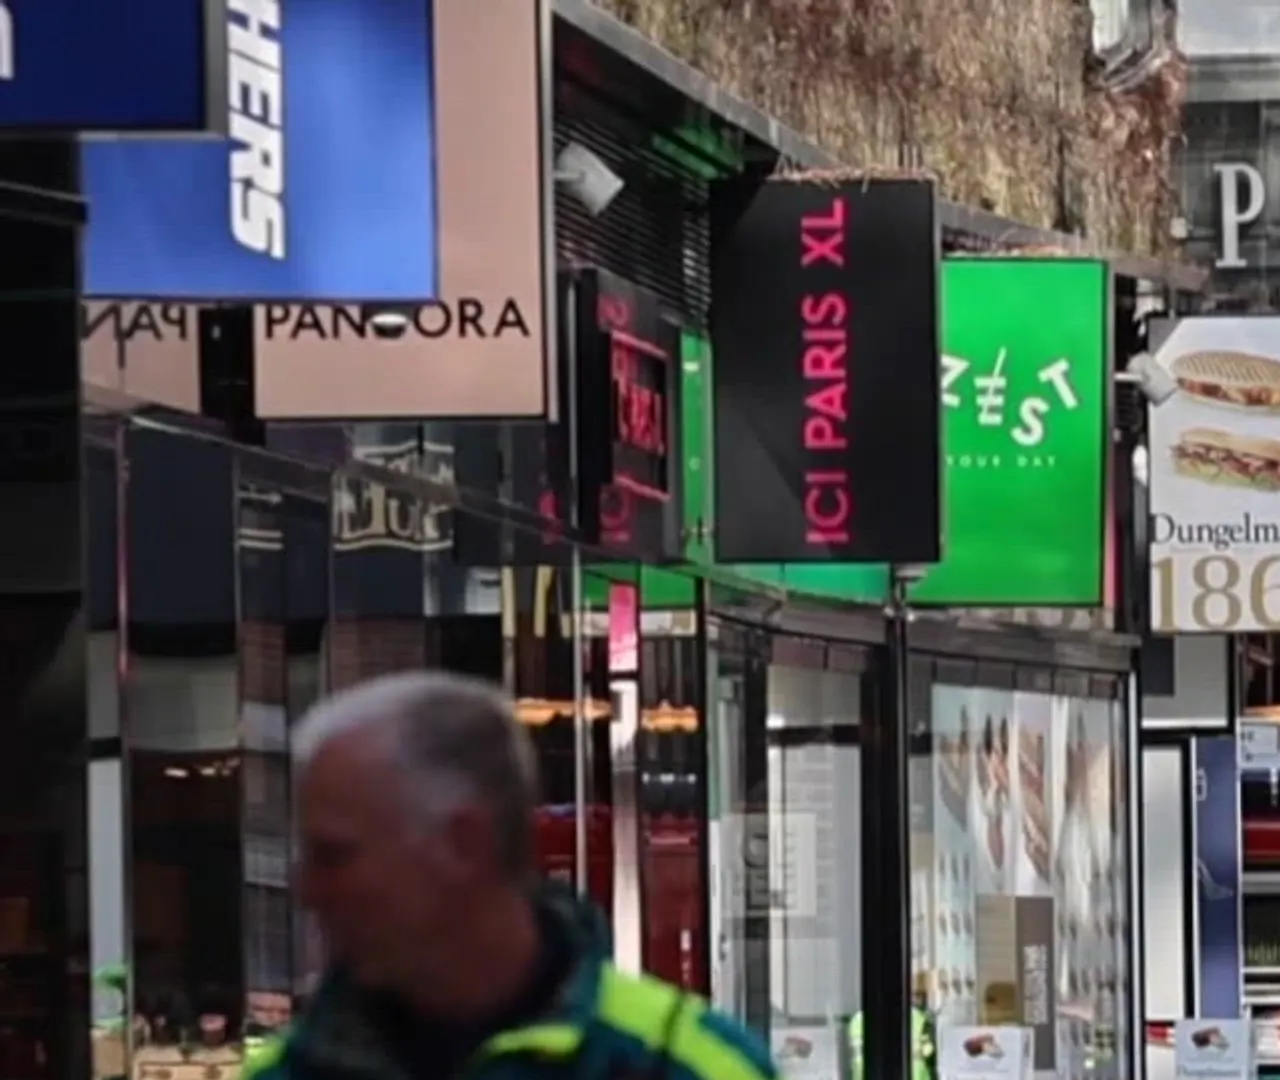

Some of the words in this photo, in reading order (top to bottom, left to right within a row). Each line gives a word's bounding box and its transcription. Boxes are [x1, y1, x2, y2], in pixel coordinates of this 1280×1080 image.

[800, 198, 846, 268] XL
[264, 298, 531, 340] PANORA
[802, 293, 848, 450] PARIS
[1017, 455, 1056, 468] DAY
[805, 472, 850, 544] ICI
